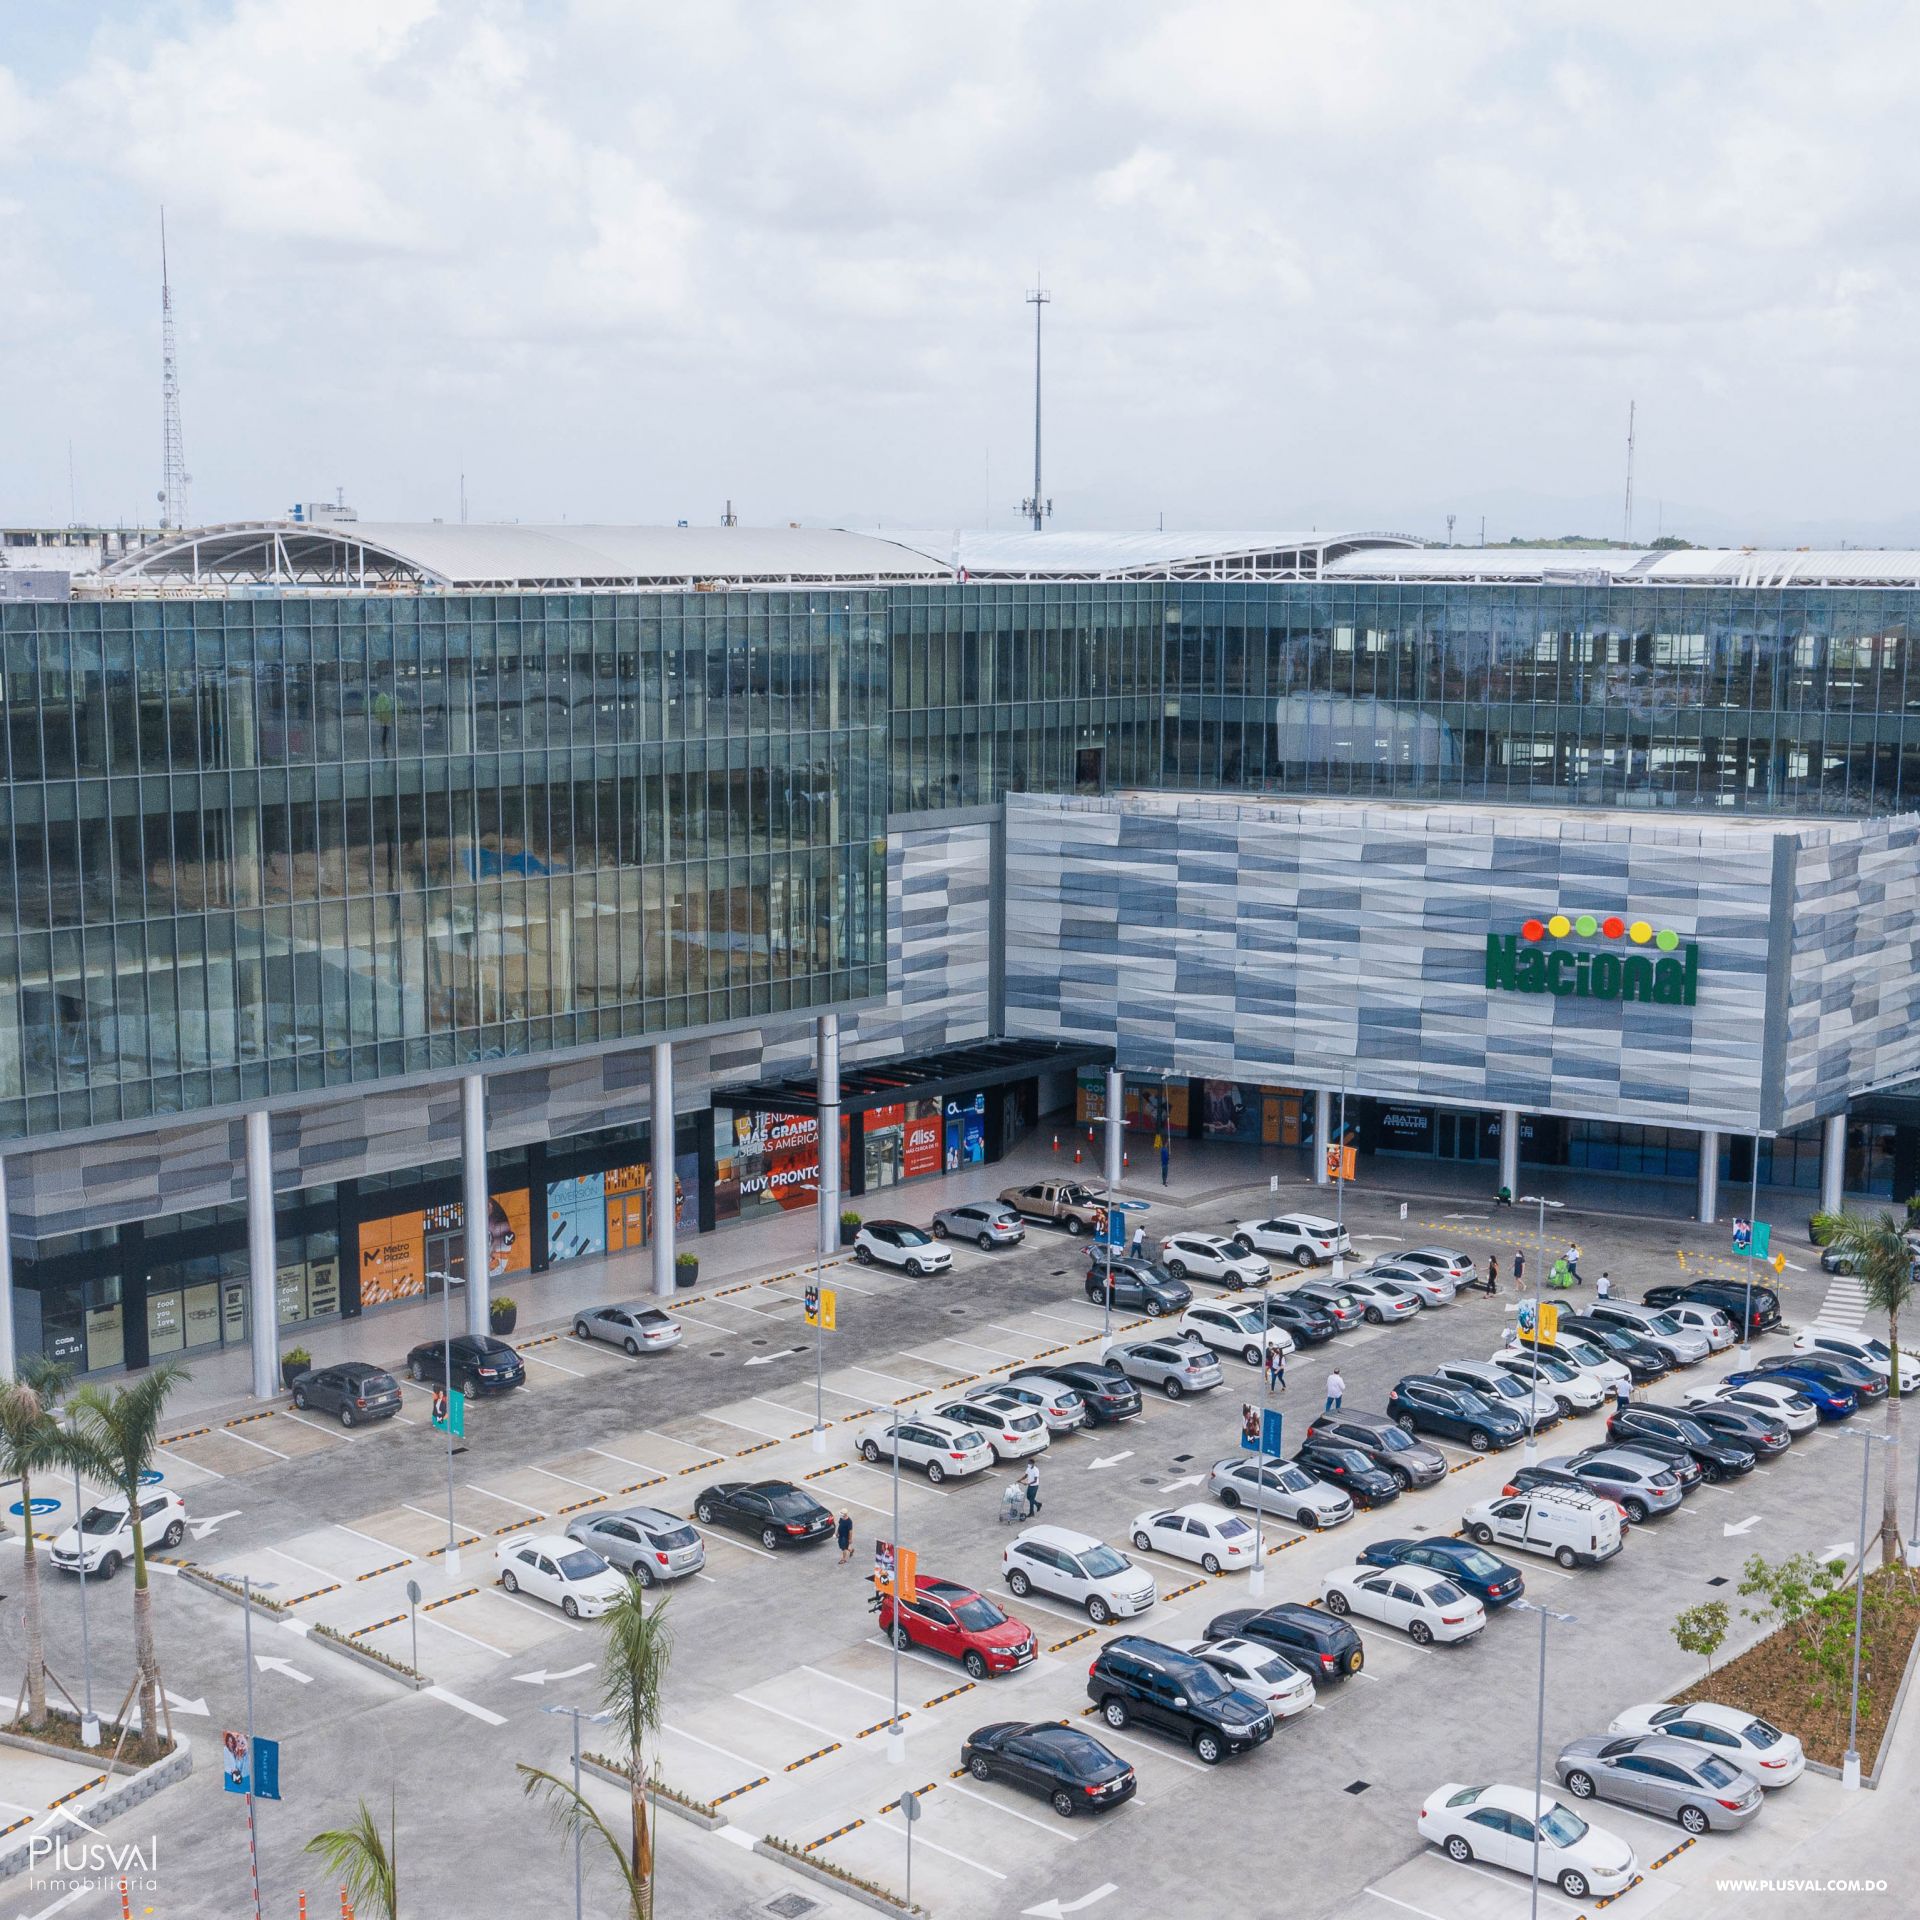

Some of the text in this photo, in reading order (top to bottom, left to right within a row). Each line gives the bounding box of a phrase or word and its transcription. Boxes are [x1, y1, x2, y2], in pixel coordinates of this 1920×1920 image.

[1486, 933, 1698, 1006] Nacional
[739, 1118, 819, 1147] MÁS GRAND
[909, 1129, 936, 1147] Aliss
[775, 1132, 819, 1151] AMÉRICA
[740, 1176, 769, 1195] MUY
[384, 1243, 410, 1254] Metro
[384, 1251, 410, 1262] Plaza
[157, 1299, 175, 1308] food
[157, 1311, 170, 1319] you
[158, 1319, 174, 1327] love
[55, 1337, 75, 1345] come
